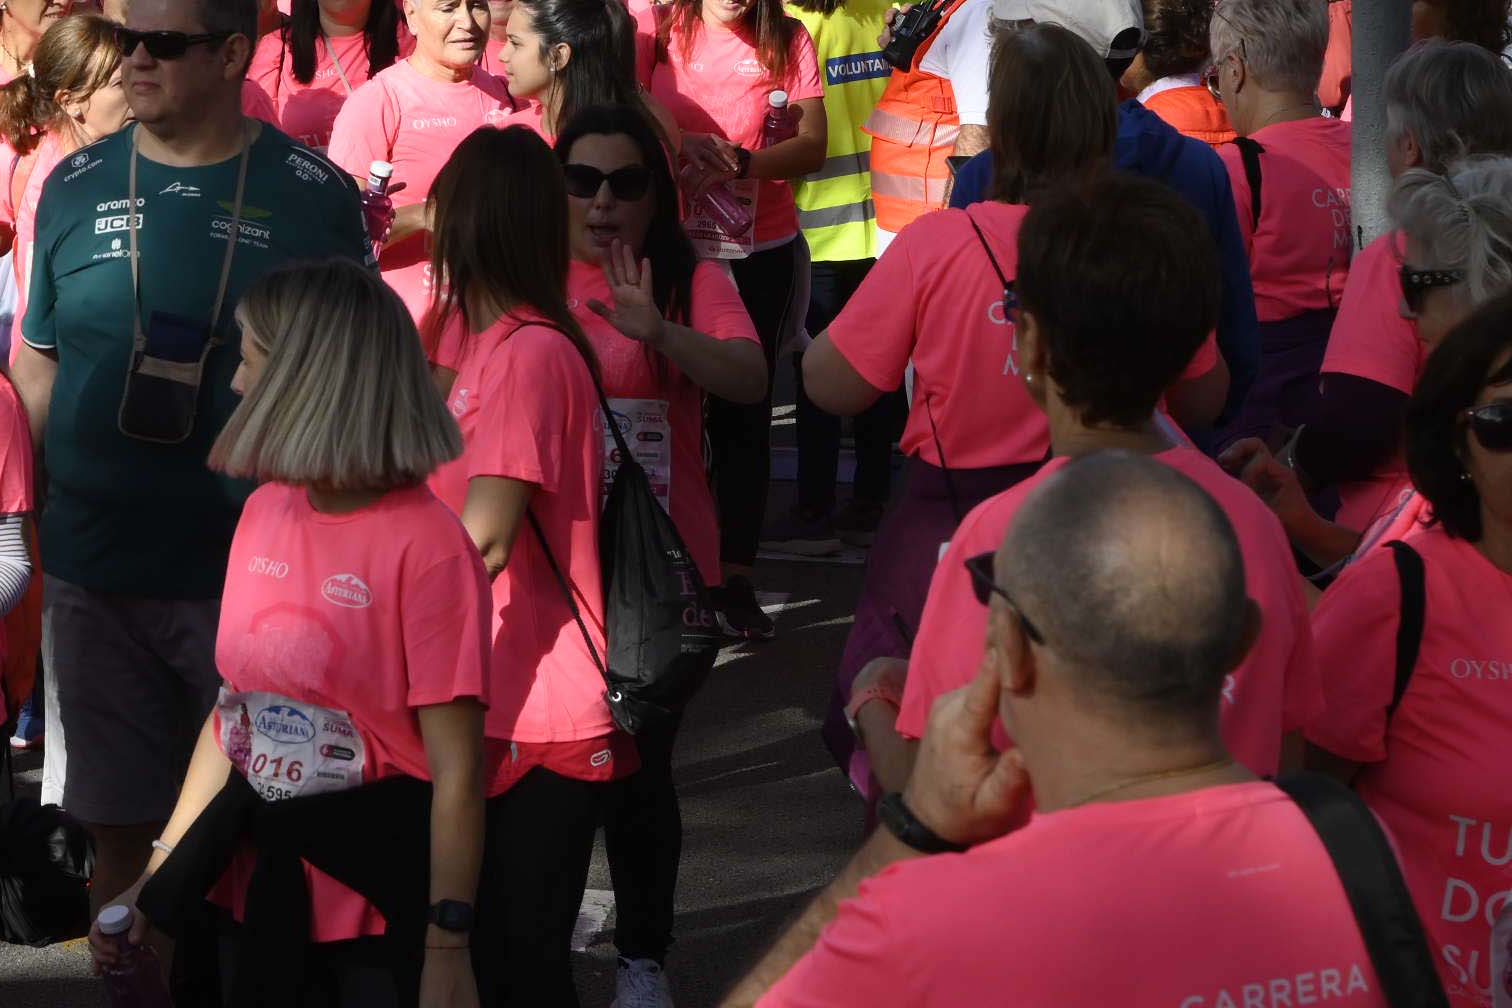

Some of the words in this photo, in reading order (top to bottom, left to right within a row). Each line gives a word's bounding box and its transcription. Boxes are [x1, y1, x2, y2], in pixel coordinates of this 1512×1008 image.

[287, 153, 329, 183] PERONI
[96, 198, 145, 212] aramo
[252, 753, 303, 783] 016
